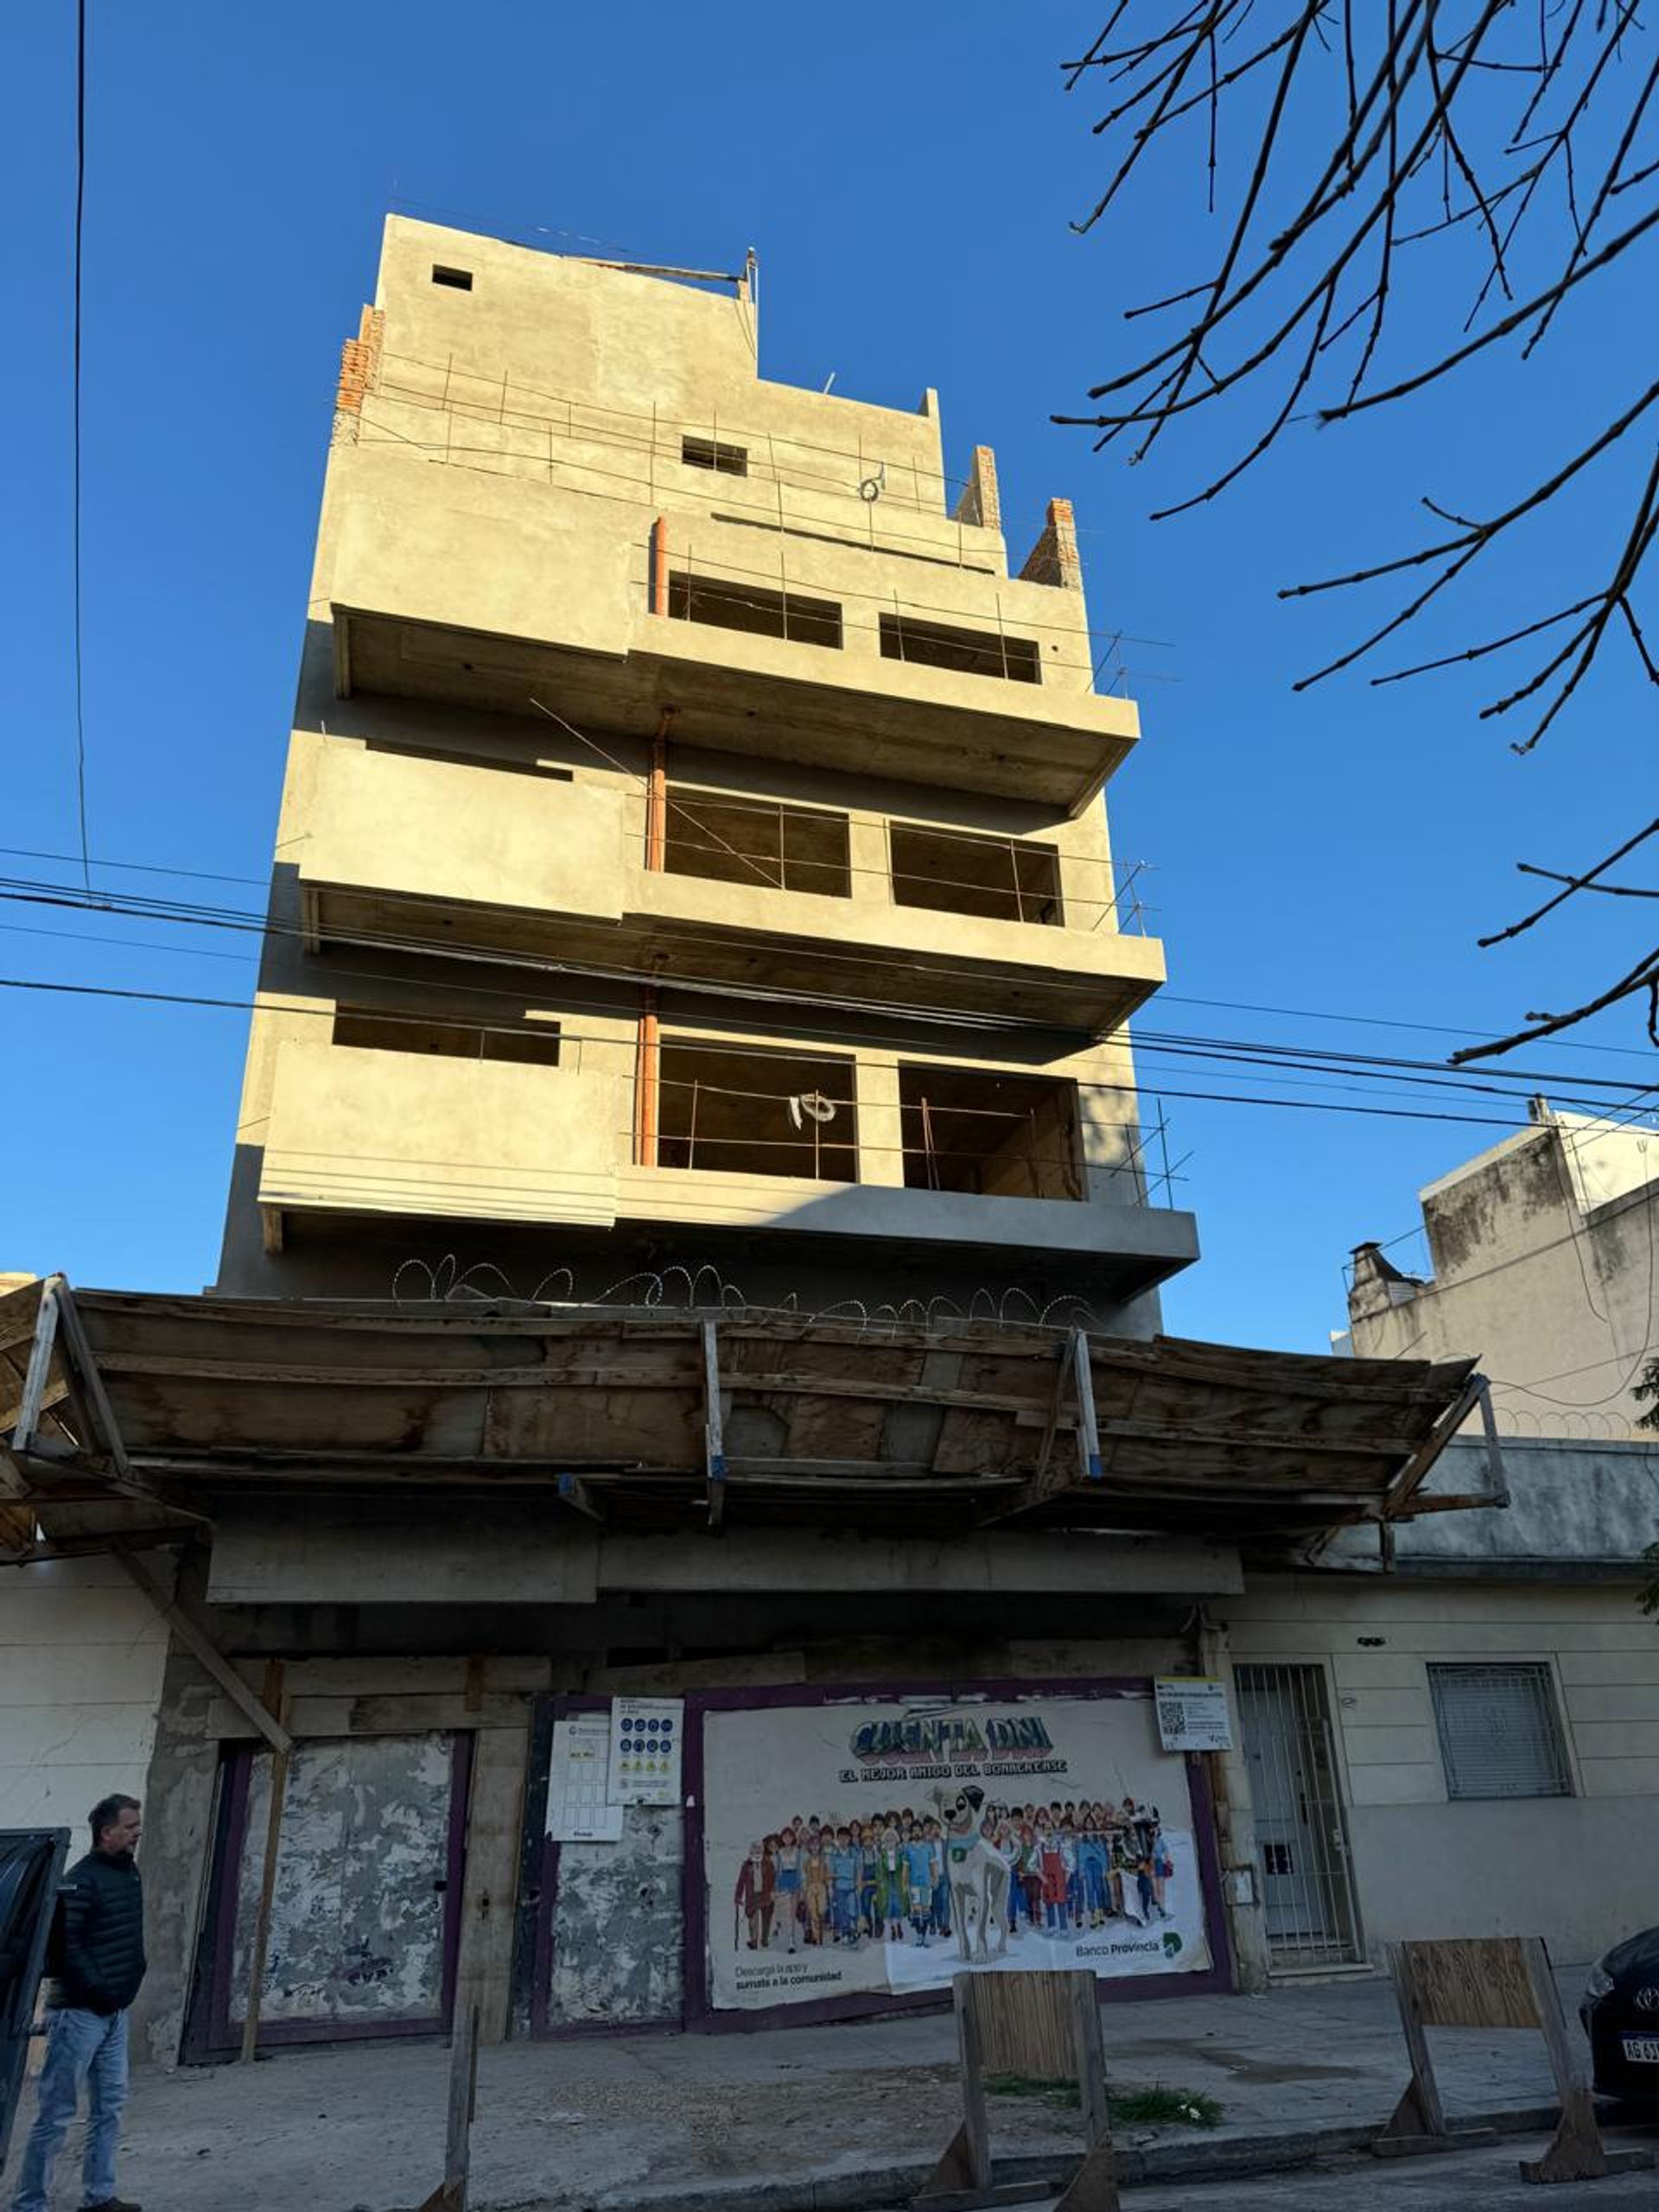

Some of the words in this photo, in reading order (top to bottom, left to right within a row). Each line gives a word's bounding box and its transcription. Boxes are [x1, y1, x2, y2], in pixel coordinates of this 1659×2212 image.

[850, 1719, 988, 1763] CUENTA
[986, 1717, 1052, 1760] DNI
[839, 1770, 858, 1783] EL
[861, 1767, 907, 1781] MEJOR
[910, 1764, 950, 1779] AMIGO
[954, 1763, 980, 1777] DEL
[983, 1760, 1067, 1776] BONAERENSE
[1076, 1945, 1108, 1957] Banco
[1111, 1942, 1159, 1955] Provincia
[777, 1964, 784, 1974] la
[736, 1978, 771, 1990] sumate
[779, 1976, 788, 1986] la
[790, 1970, 842, 1985] comunidad
